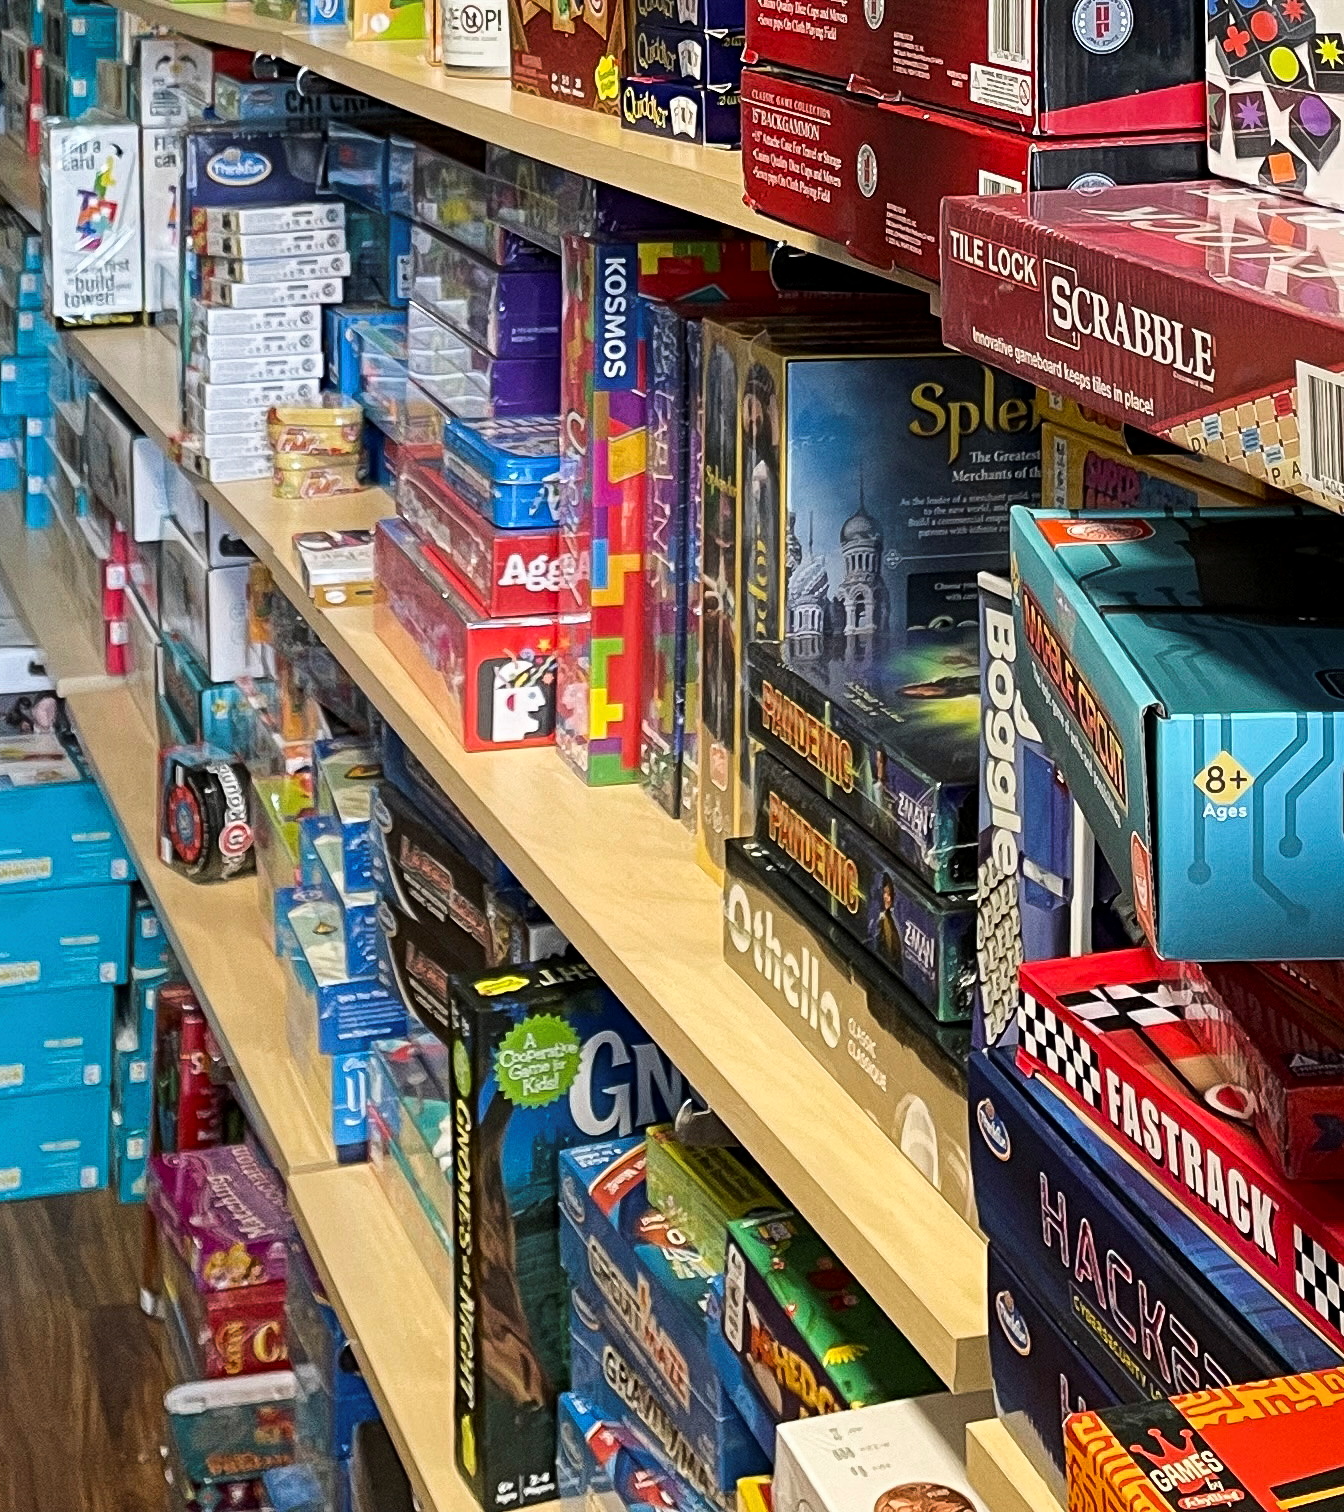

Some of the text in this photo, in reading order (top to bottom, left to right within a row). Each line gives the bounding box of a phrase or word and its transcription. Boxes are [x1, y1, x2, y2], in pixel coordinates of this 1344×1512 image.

[949, 230, 1038, 287] TILE LOCK
[603, 256, 628, 379] KOSMOS
[1051, 275, 1216, 384] SCRABBLE
[972, 325, 1155, 418] Innovative gameboard keeps tiles in place!
[969, 448, 1042, 465] The Greatest
[761, 679, 854, 795] PANDEMIC
[985, 607, 1023, 877] Boggle
[1201, 765, 1247, 794] 8+
[1202, 798, 1248, 822] Ages
[767, 791, 860, 916] PANDEMIC
[725, 883, 841, 1050] Othello
[499, 1042, 579, 1069] Cooperative
[522, 1032, 538, 1050] A
[508, 1060, 549, 1082] Game
[522, 1072, 560, 1096] Kids!
[455, 1098, 472, 1257] GNOMES
[1105, 1065, 1280, 1268] FASTRACK
[1149, 1449, 1225, 1493] GAMES
[1205, 1477, 1225, 1493] by
